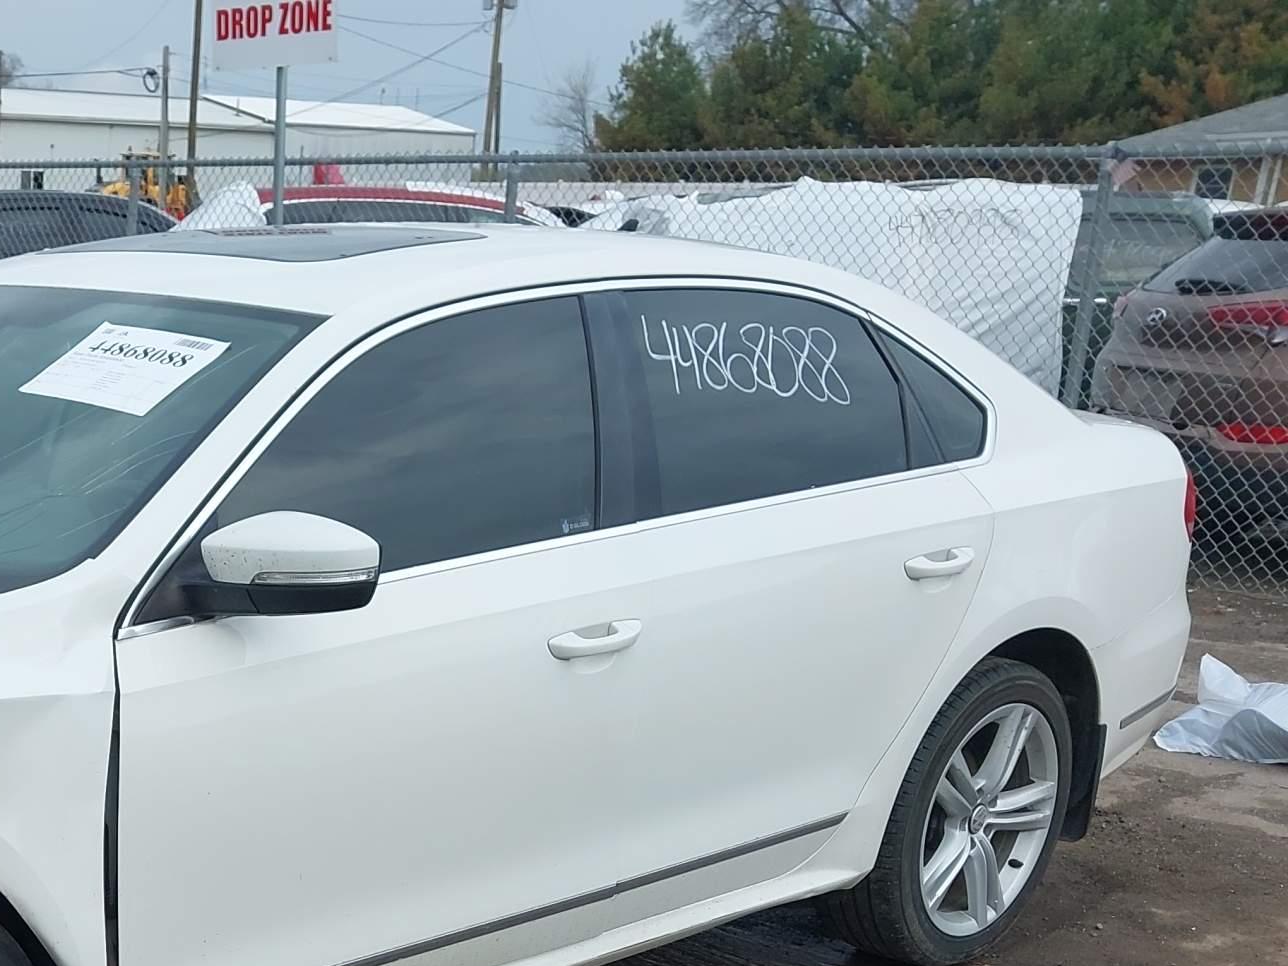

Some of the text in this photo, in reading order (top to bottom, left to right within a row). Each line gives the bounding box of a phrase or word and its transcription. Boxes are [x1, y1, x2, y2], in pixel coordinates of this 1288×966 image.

[216, 0, 332, 41] DROP ZONE
[88, 340, 194, 368] 44868088
[640, 314, 851, 405] 44868088
